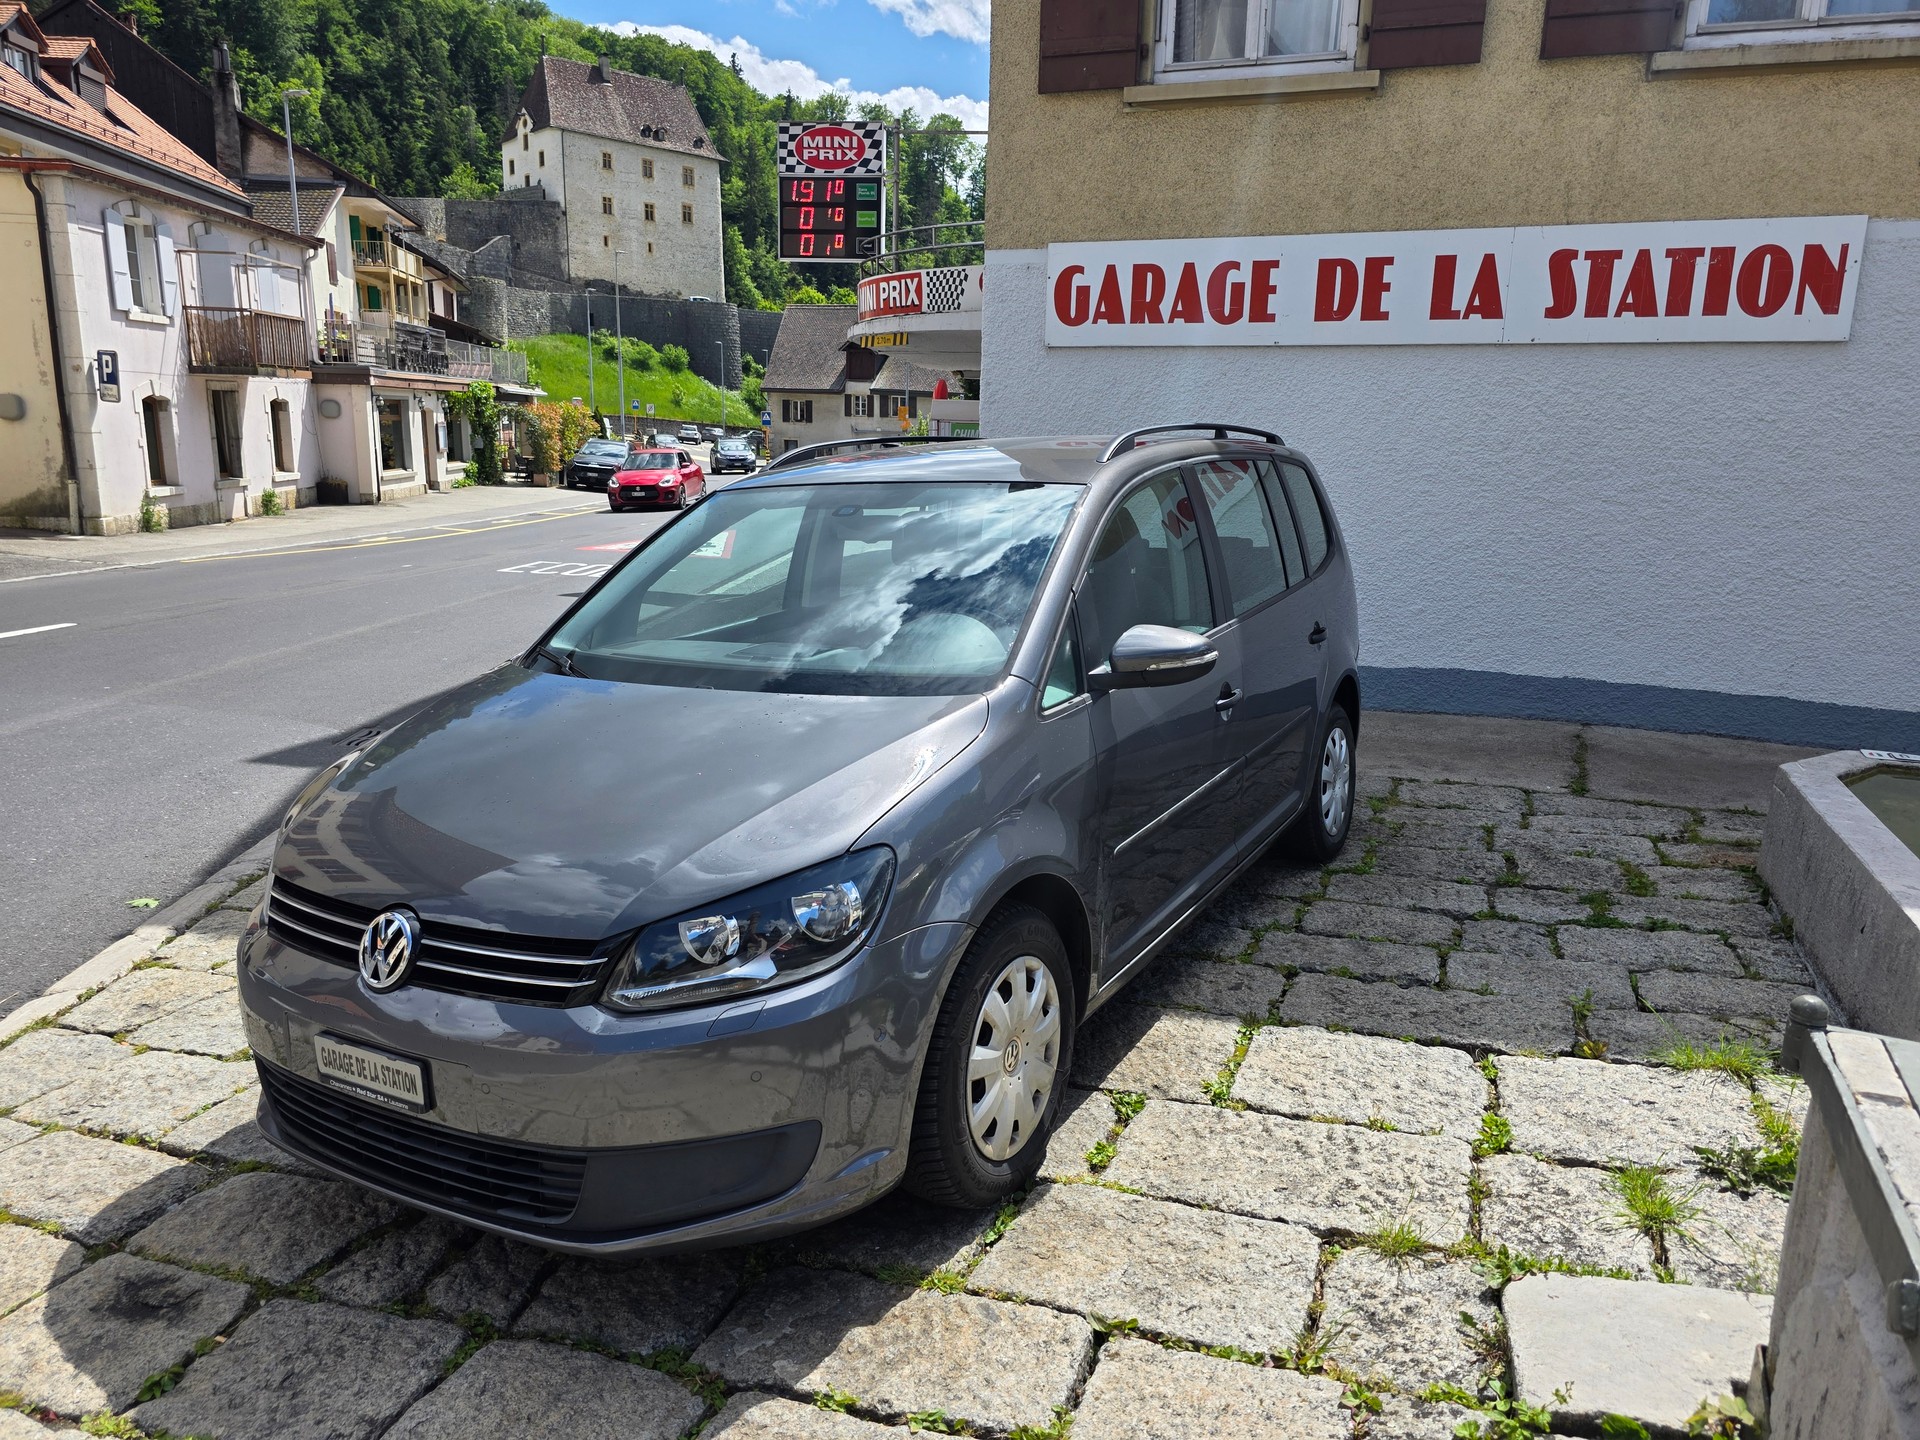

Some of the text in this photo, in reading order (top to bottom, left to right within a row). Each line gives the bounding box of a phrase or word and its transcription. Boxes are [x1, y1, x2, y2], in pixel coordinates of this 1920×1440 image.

[803, 136, 858, 148] MINI
[803, 149, 859, 161] PRIX
[880, 277, 920, 309] PRIX
[1054, 243, 1850, 327] GARAGE DE LA STATION
[102, 354, 113, 382] P
[321, 1046, 419, 1096] GARAGE DE LA STATION
[356, 1087, 367, 1096] Red
[366, 1090, 377, 1099] Star
[376, 1094, 385, 1102] SA
